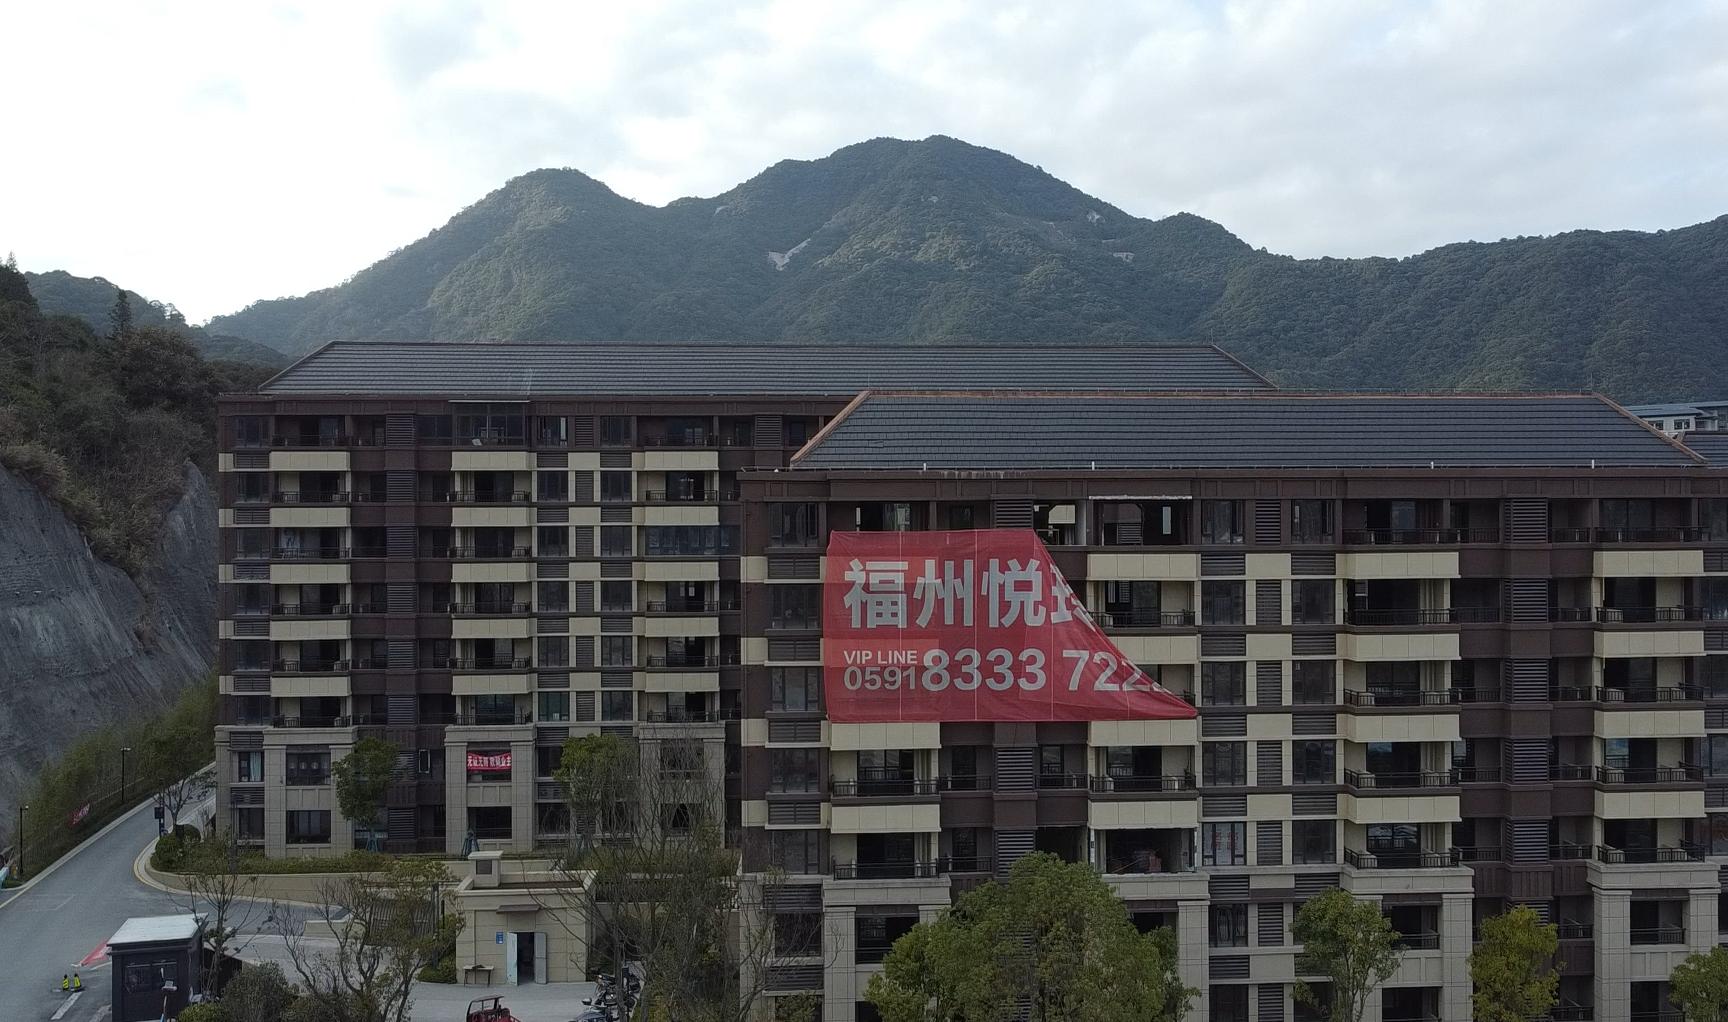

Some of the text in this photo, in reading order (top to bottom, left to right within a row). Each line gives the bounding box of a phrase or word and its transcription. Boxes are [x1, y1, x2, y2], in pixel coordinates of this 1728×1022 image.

[843, 650, 918, 664] VIP LINE
[843, 648, 1172, 692] 0591 8333 722
